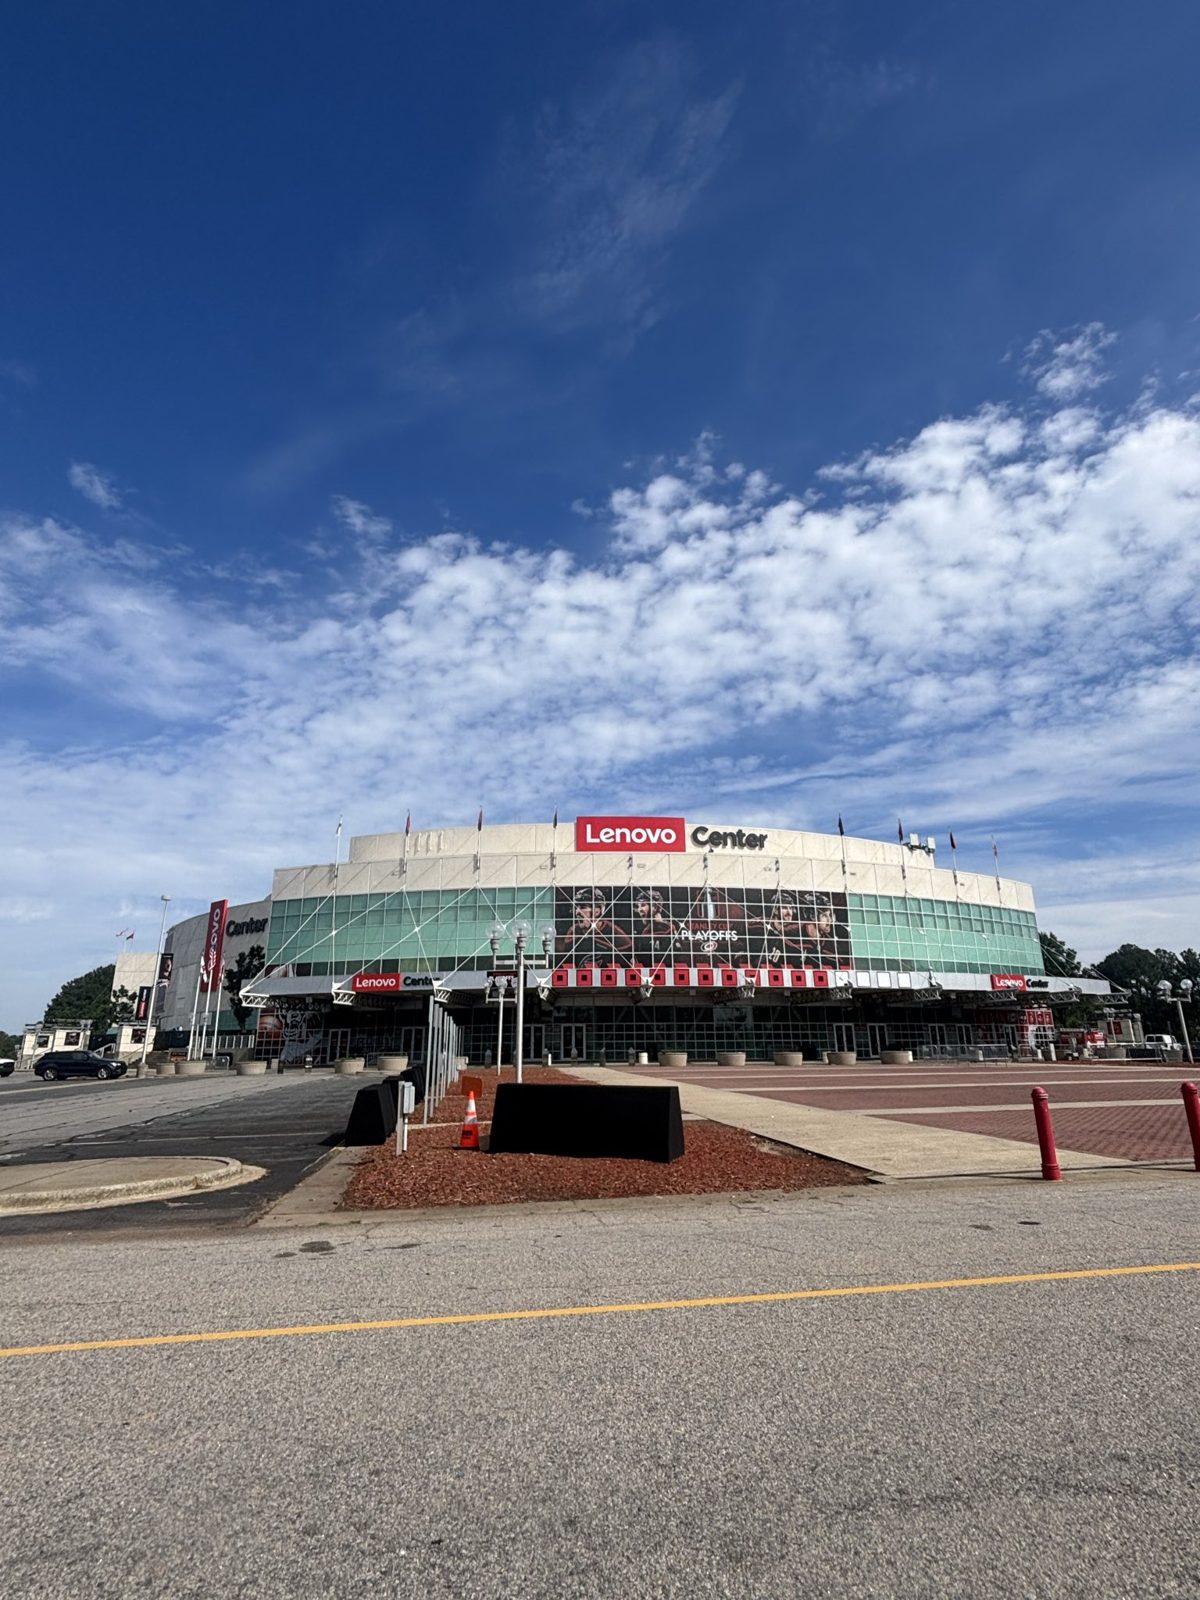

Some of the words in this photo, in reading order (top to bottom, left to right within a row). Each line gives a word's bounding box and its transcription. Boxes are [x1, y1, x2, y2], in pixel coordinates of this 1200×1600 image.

[586, 824, 676, 843] Lenovo
[691, 826, 767, 848] Center
[225, 917, 268, 937] Center
[681, 930, 738, 941] PLAYOFFS
[208, 908, 221, 971] Lnovo
[356, 978, 396, 988] Lenovo
[403, 976, 440, 986] Cent
